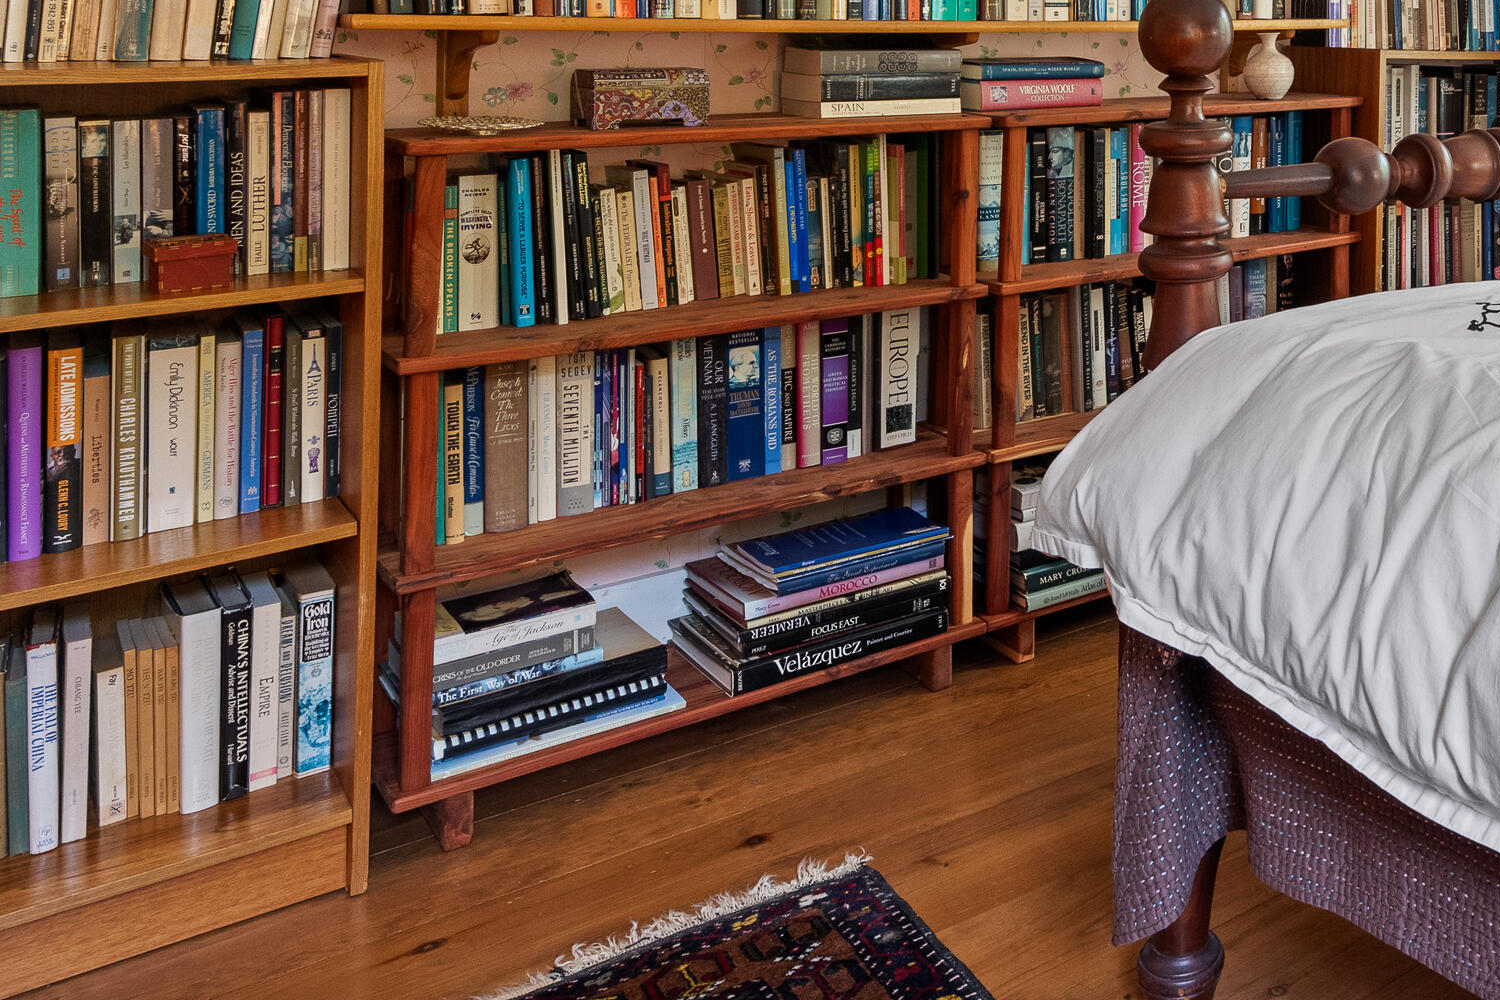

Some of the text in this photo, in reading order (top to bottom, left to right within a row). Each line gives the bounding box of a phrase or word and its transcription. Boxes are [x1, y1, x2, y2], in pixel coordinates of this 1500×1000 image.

[831, 103, 865, 112] SPAIN
[1019, 84, 1076, 95] VIRGINIA WOOLF
[179, 133, 192, 162] perfume
[745, 186, 753, 205] Eats,
[1132, 162, 1144, 207] ROME
[253, 176, 265, 232] LUTHER
[746, 207, 754, 232] Shoots
[1057, 180, 1066, 243] BONAPARTE
[748, 241, 756, 265] Leaves
[446, 283, 454, 317] SPEARS
[703, 340, 713, 385] VIETNAM
[888, 313, 909, 405] EUROPE
[1022, 346, 1028, 355] IN
[715, 361, 724, 383] OUR
[784, 370, 792, 391] EPIC
[60, 355, 76, 441] LATE ADMISSIONS
[165, 363, 183, 429] Emily Dickinson
[307, 374, 321, 407] PARIS
[328, 393, 338, 437] POMPEII
[447, 400, 460, 485] TOUCH THE EARTH
[563, 385, 578, 484] SEVENTH MILLION
[92, 435, 102, 483] Liberties
[119, 398, 136, 522] CHARLES KRAUTHAMMER
[819, 575, 878, 598] MOROCCO
[1040, 572, 1063, 584] MARY
[751, 618, 810, 640] VERMEER
[811, 616, 859, 636] FOCUS EAST
[774, 640, 862, 676] Velázquez
[236, 619, 248, 762] CHINA'S INTELLECTUALS
[259, 676, 273, 717] EMPIRE
[438, 669, 541, 703] The First Way of War
[31, 686, 44, 772] IMPERIAL CHINA
[45, 683, 56, 743] THE FALL OF
